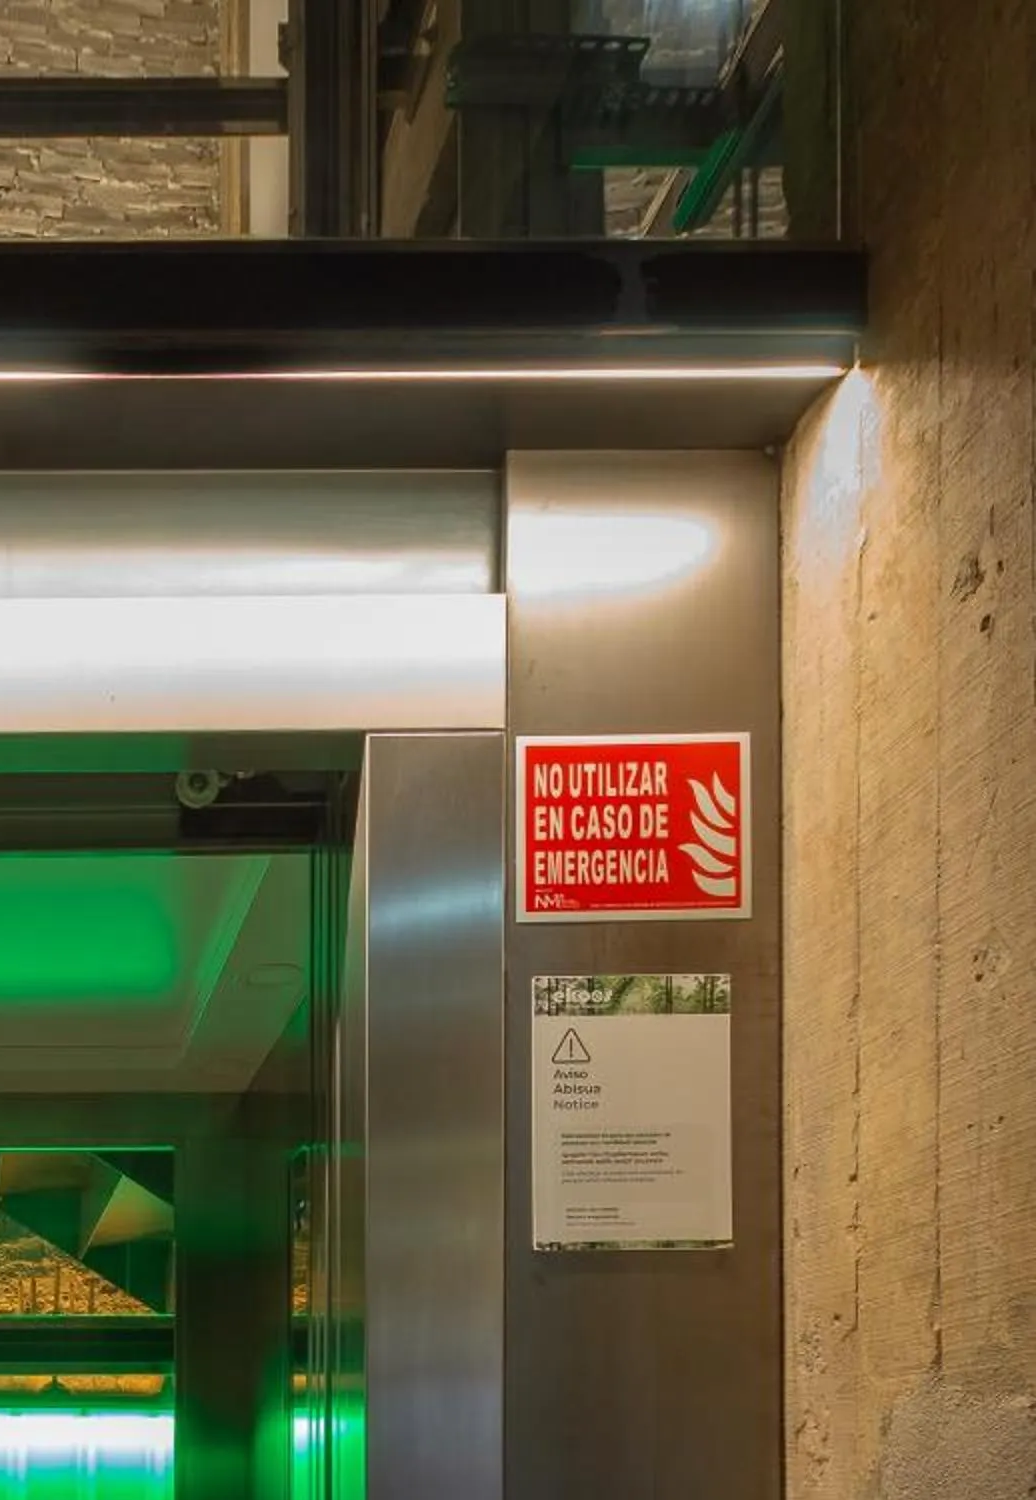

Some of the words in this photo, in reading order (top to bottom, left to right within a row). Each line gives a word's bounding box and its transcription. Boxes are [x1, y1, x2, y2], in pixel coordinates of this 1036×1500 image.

[534, 763, 564, 798] NO
[568, 761, 668, 798] UTILIZAR
[534, 805, 564, 840] EN
[571, 804, 633, 840] CASO
[639, 804, 669, 838] DE
[534, 848, 669, 885] EMERGENCIA
[553, 1068, 589, 1079] Aviso
[553, 1083, 601, 1095] Abisua
[553, 1098, 599, 1110] Notice
